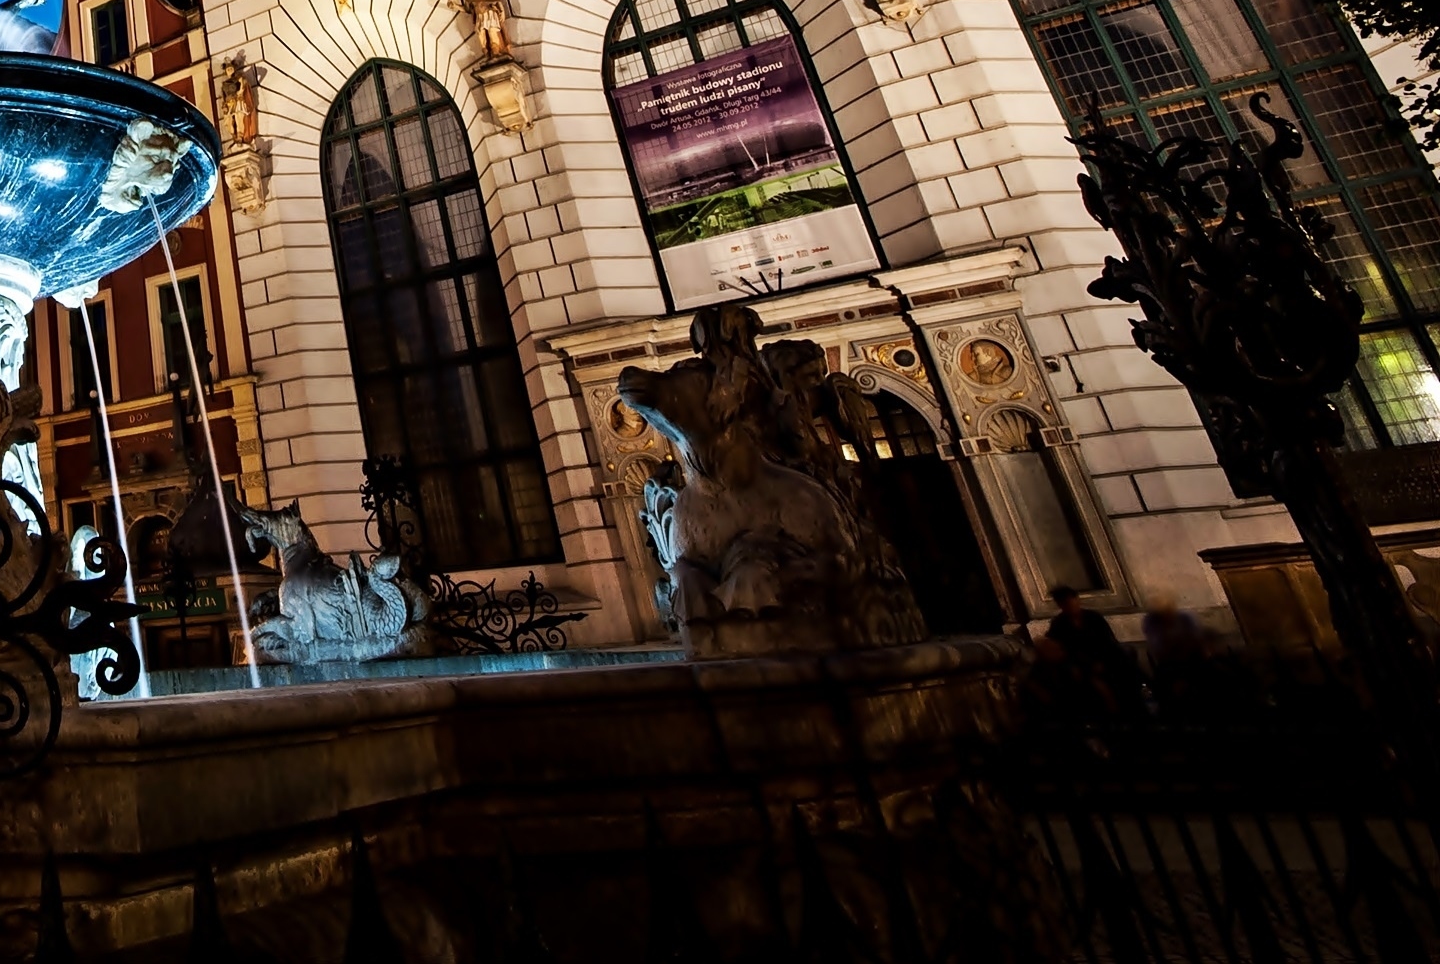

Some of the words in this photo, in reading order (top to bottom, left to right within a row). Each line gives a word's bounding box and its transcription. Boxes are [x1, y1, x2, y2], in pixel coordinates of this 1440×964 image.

[665, 76, 697, 90] Wystawa
[697, 62, 742, 82] fotograficzna
[691, 75, 734, 95] budowy
[736, 61, 783, 82] stadionu
[650, 119, 668, 130] Dwór
[670, 112, 693, 125] Artusa,
[723, 98, 742, 110] Długi
[742, 94, 759, 107] Targ
[760, 86, 782, 97] 43/44
[660, 98, 698, 116] trudem
[699, 89, 725, 105] ludzi
[672, 116, 711, 133] 24.05.2012
[719, 102, 759, 119] 30.09.2012
[696, 118, 748, 139] www.mhmg.pl
